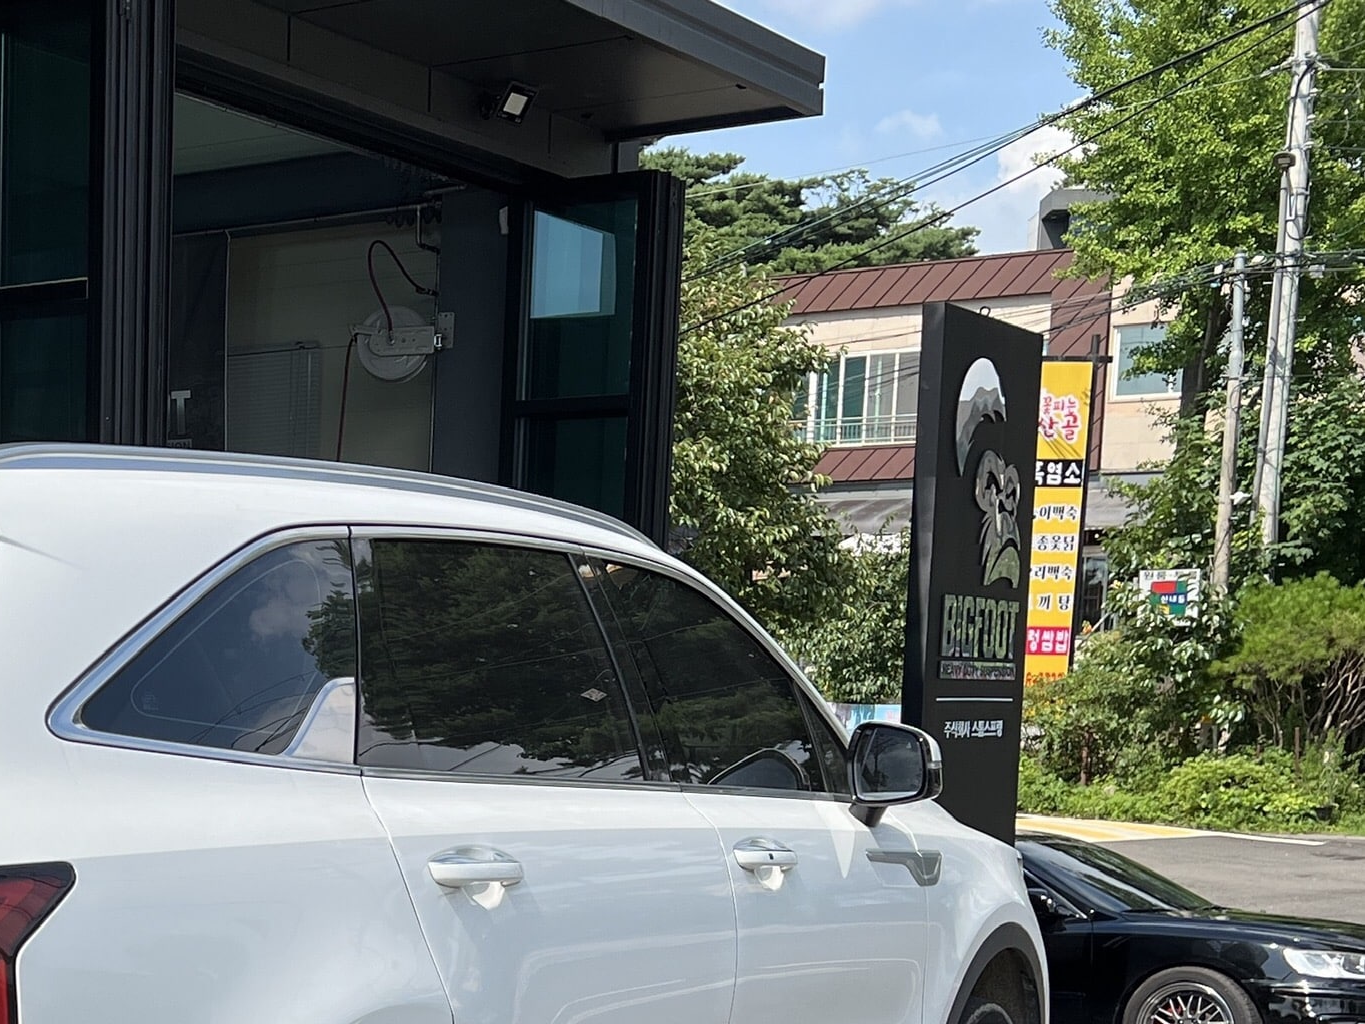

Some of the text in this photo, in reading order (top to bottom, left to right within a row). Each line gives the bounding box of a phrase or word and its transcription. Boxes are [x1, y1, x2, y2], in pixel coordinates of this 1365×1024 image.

[1033, 505, 1077, 520] 이백숙
[1037, 535, 1075, 551] 종옻닭
[1030, 565, 1073, 580] 리백숙
[941, 594, 1020, 659] BIGFOOT
